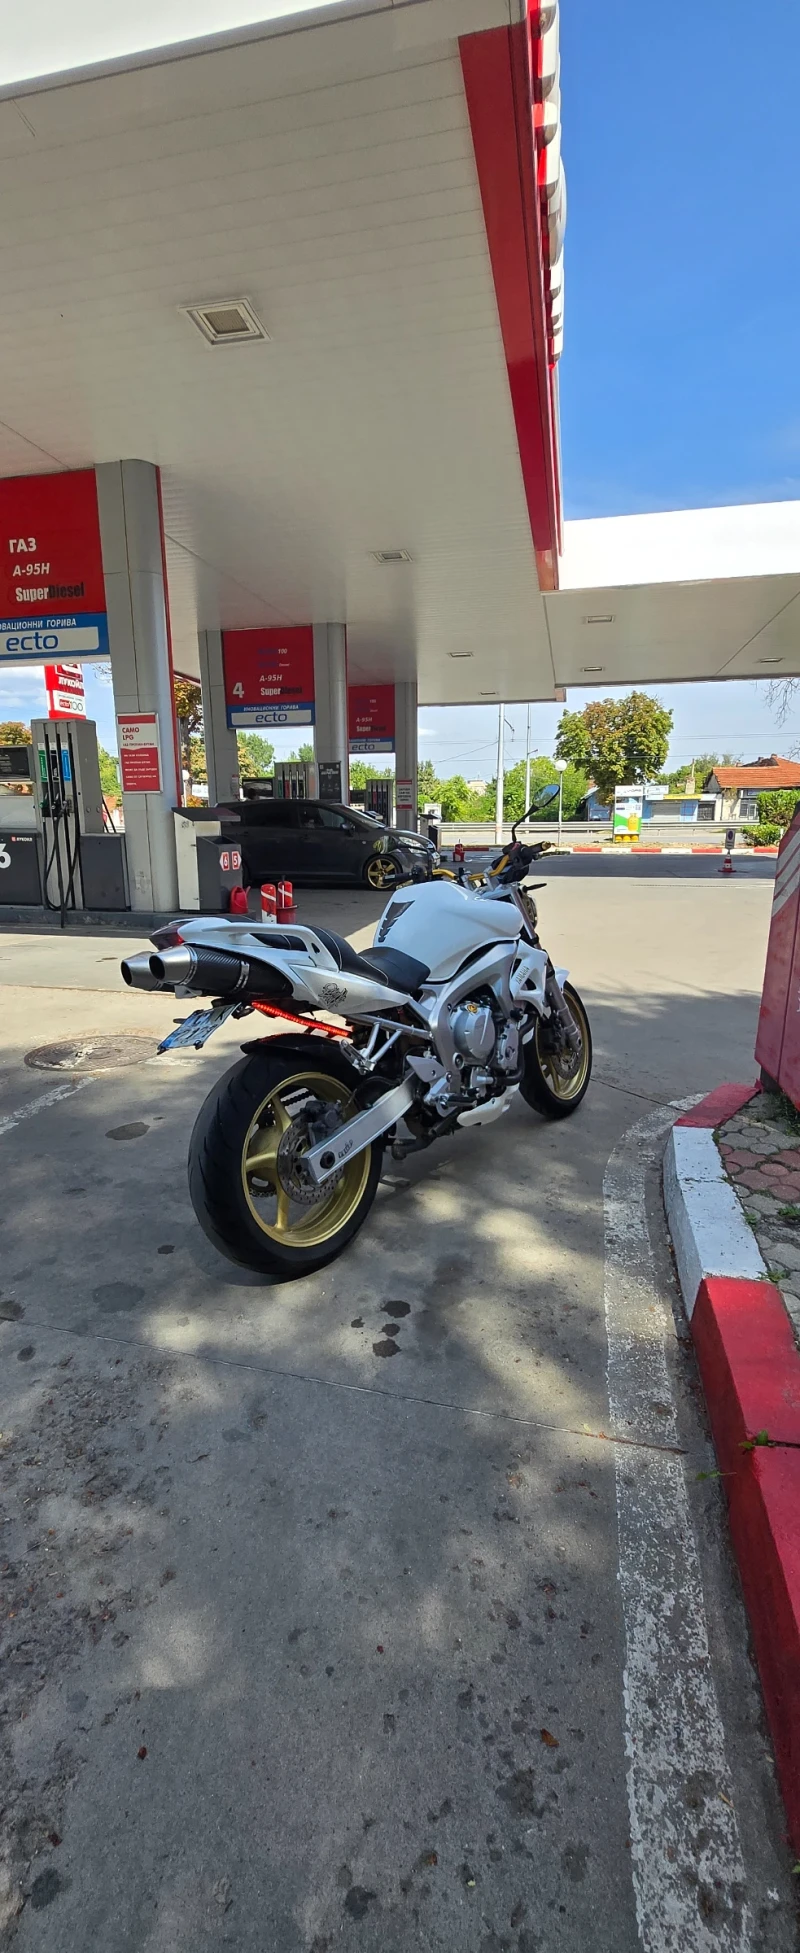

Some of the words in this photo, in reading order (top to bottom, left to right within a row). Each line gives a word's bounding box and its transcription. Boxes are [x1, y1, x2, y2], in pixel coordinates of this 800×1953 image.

[9, 537, 37, 553] ГАЗ
[15, 582, 85, 602] SuperDiesel
[0, 620, 43, 631] ВАЦИОННИ
[46, 618, 77, 627] ГОРИВА
[6, 631, 59, 652] ecto
[232, 682, 245, 699] 4
[255, 712, 288, 723] ecto
[351, 743, 375, 751] ecto
[0, 843, 12, 869] 6
[223, 856, 228, 867] 6
[233, 855, 238, 866] 5
